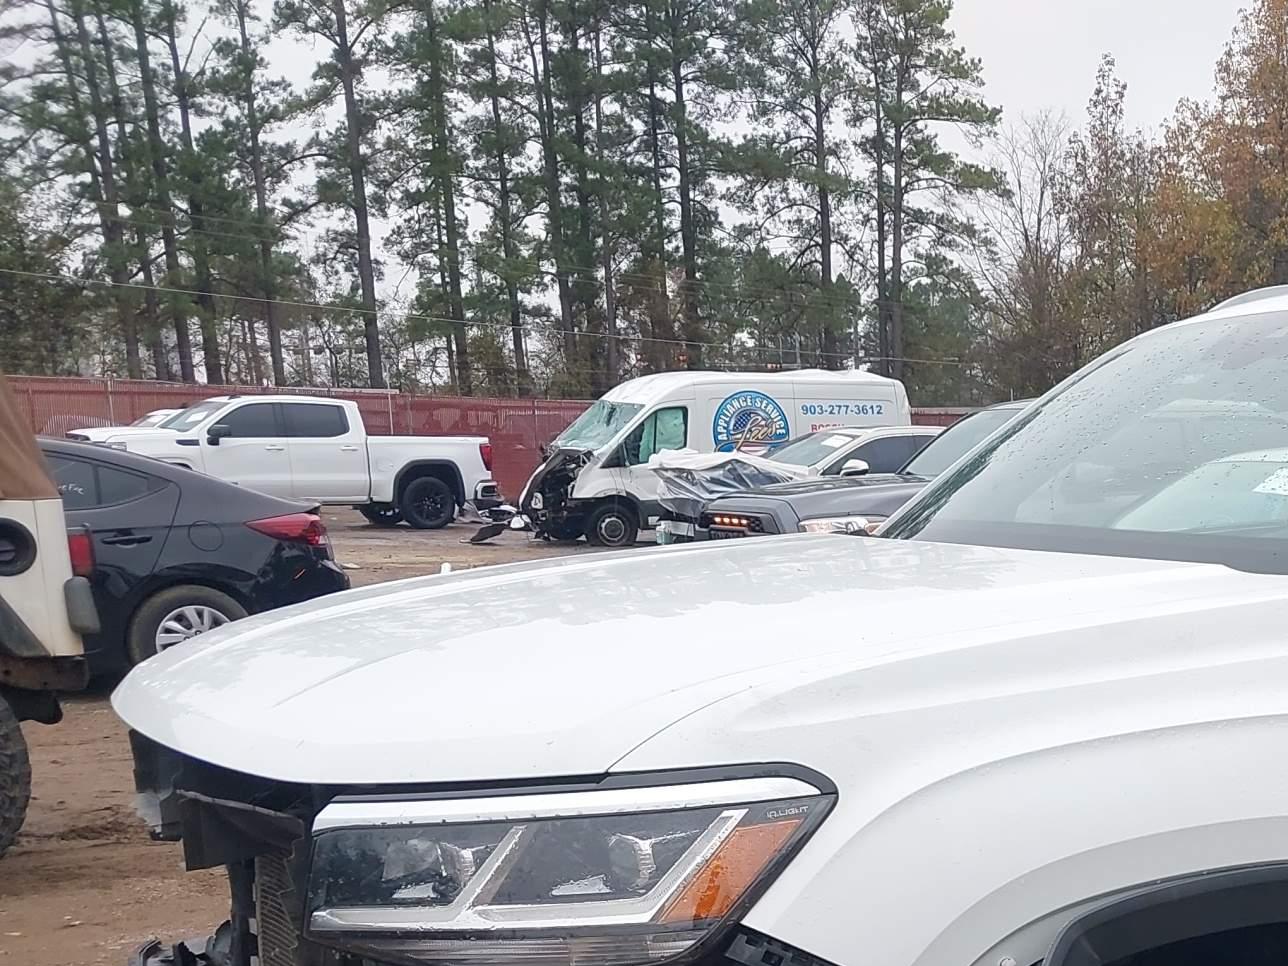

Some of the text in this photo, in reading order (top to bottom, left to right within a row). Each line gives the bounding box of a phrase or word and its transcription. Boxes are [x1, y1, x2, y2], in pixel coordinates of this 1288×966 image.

[717, 394, 786, 441] APPLIANCE SERVICE
[801, 404, 883, 416] 903-277-3612
